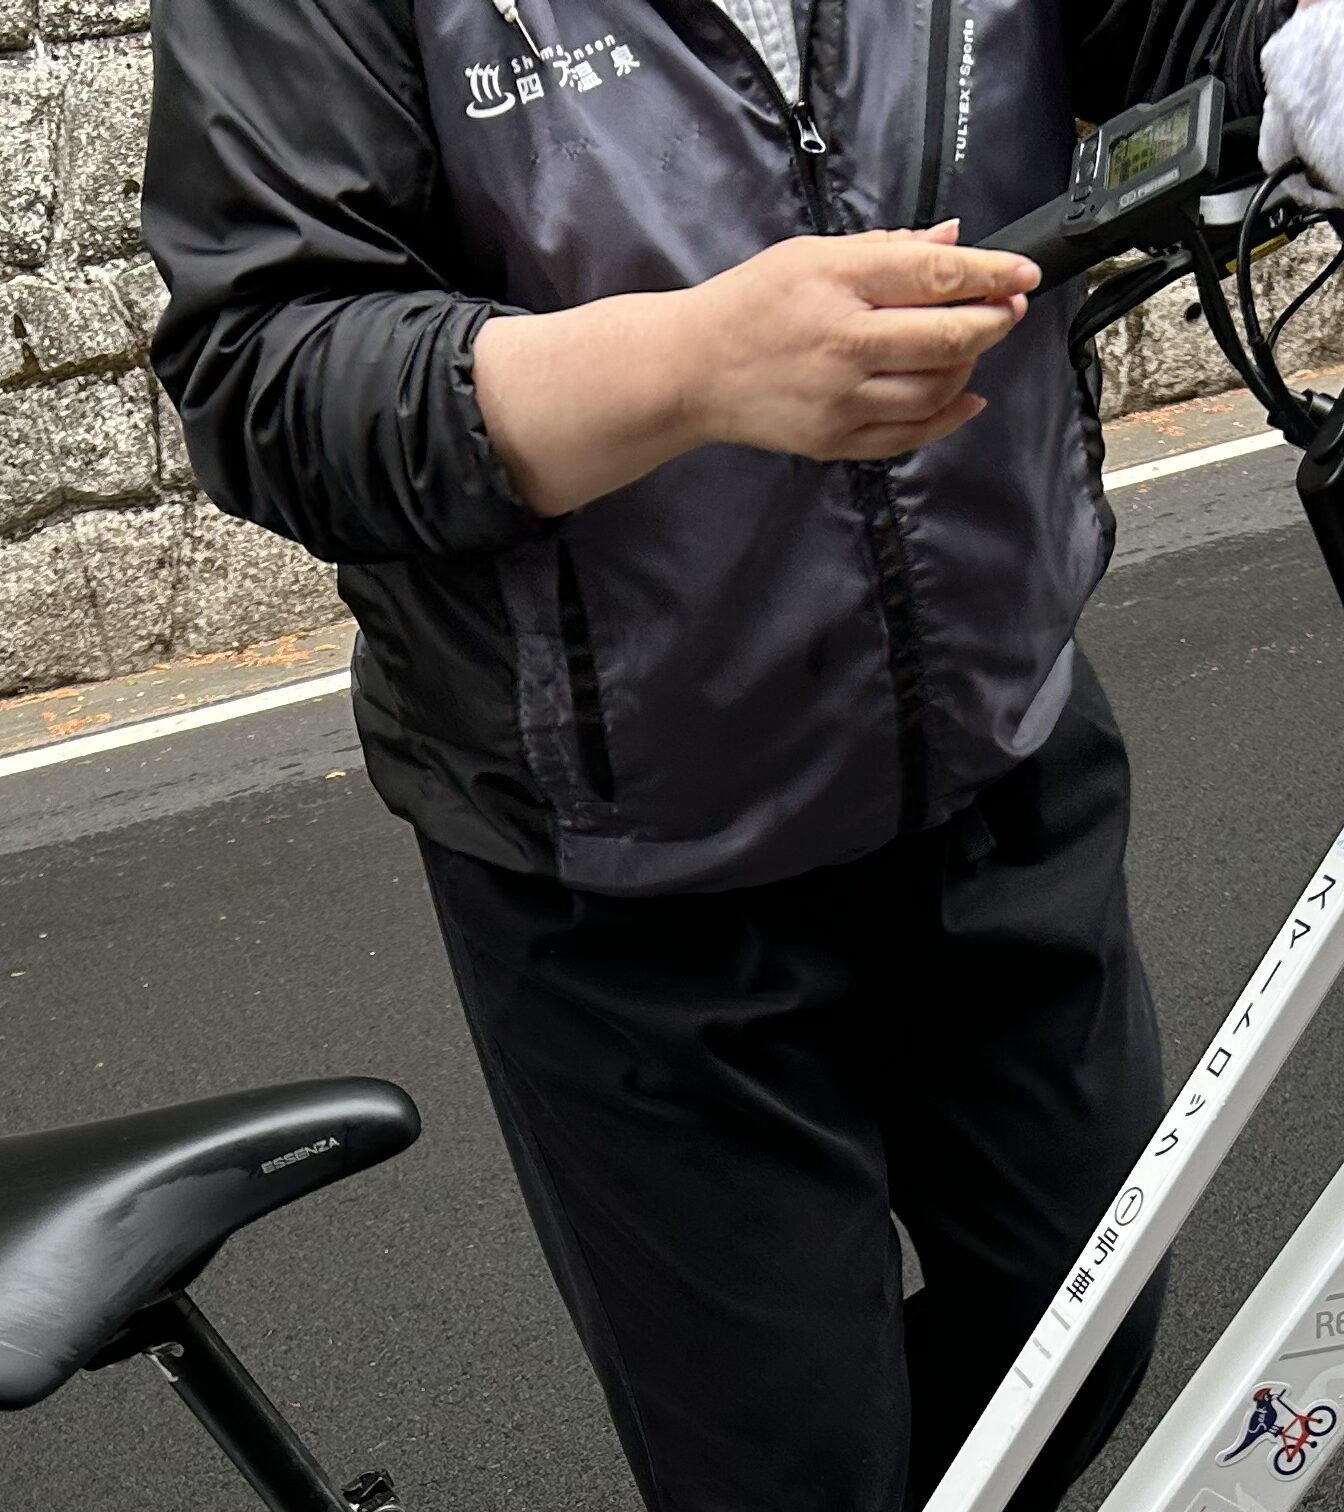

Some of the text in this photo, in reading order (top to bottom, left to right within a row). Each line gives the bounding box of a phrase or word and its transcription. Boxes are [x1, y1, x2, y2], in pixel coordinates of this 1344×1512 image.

[511, 42, 564, 72] Shma
[1154, 874, 1336, 1157] スマートロック
[261, 1137, 341, 1174] ESSENZA
